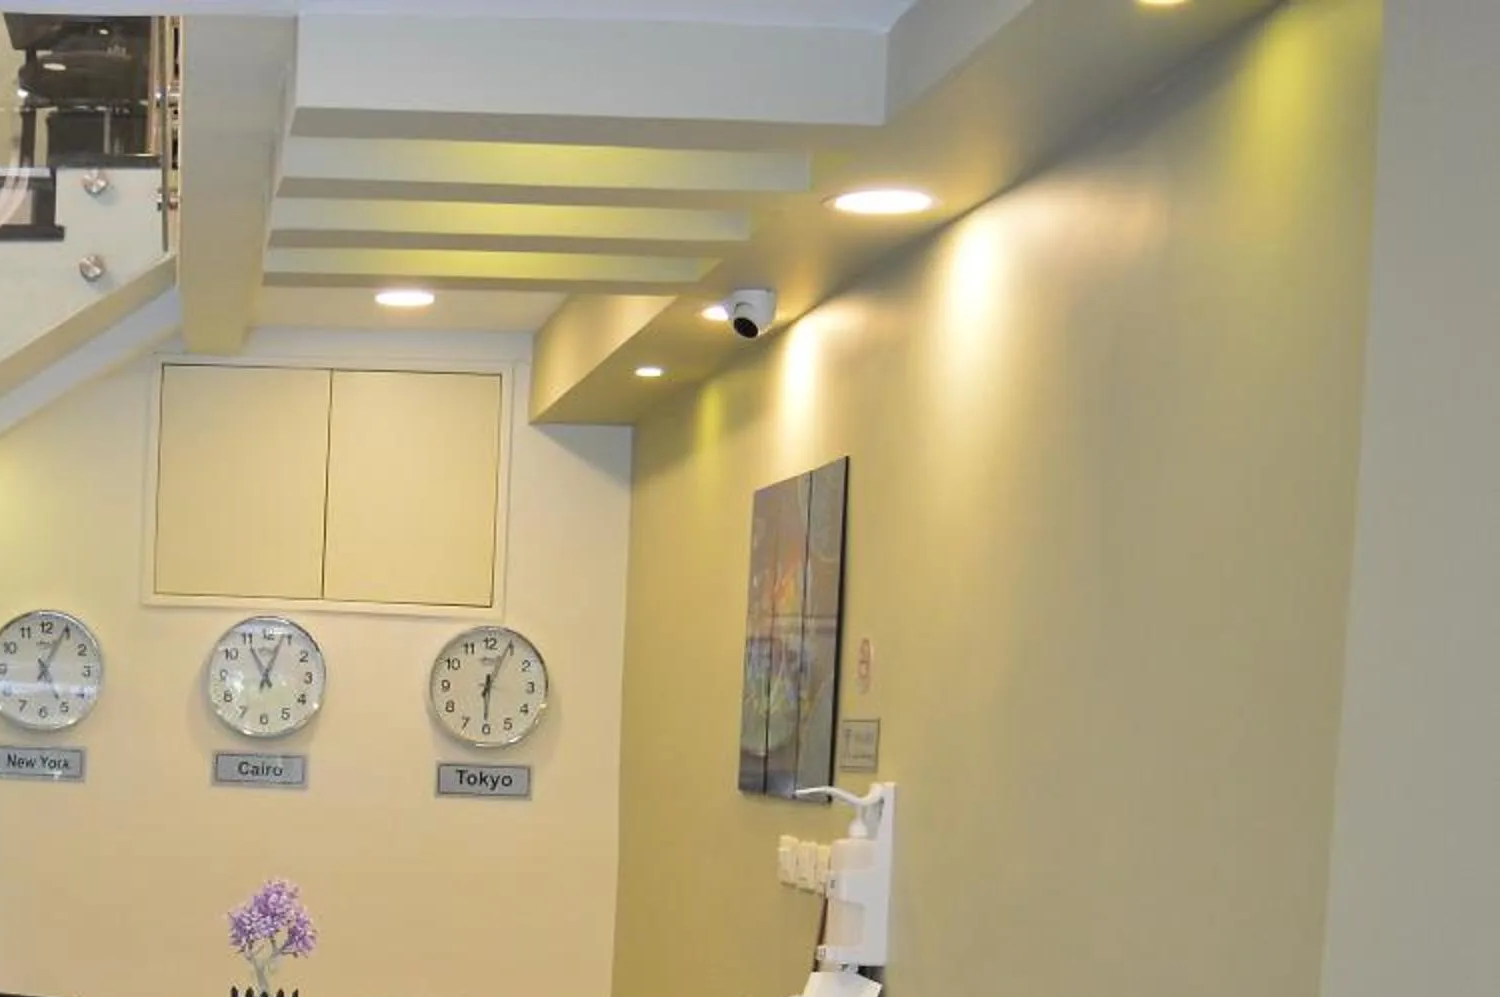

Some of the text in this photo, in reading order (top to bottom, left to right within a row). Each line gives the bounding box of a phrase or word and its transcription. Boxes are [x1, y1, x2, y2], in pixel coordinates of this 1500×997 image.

[20, 627, 31, 638] 11
[40, 622, 53, 634] 12
[242, 634, 252, 645] 11
[484, 637, 497, 650] 12
[4, 642, 17, 654] 10
[77, 644, 87, 656] 2
[224, 648, 238, 660] 10
[463, 643, 474, 654] 11
[299, 652, 308, 663] 2
[446, 659, 460, 670] 10
[522, 660, 531, 671] 2
[82, 666, 91, 677] 3
[304, 672, 312, 684] 3
[441, 680, 450, 692] 9
[526, 682, 535, 694] 3
[223, 691, 232, 703] 8
[298, 694, 306, 704] 4
[19, 700, 27, 712] 7
[60, 702, 69, 713] 5
[238, 706, 247, 718] 7
[446, 700, 455, 712] 8
[520, 703, 528, 714] 4
[39, 708, 48, 718] 6
[281, 708, 290, 720] 5
[260, 714, 268, 725] 6
[461, 716, 470, 729] 7
[504, 718, 513, 730] 5
[482, 724, 491, 735] 6
[6, 754, 70, 769] New York
[238, 761, 283, 776] Cairo
[456, 769, 513, 790] Tokyo
